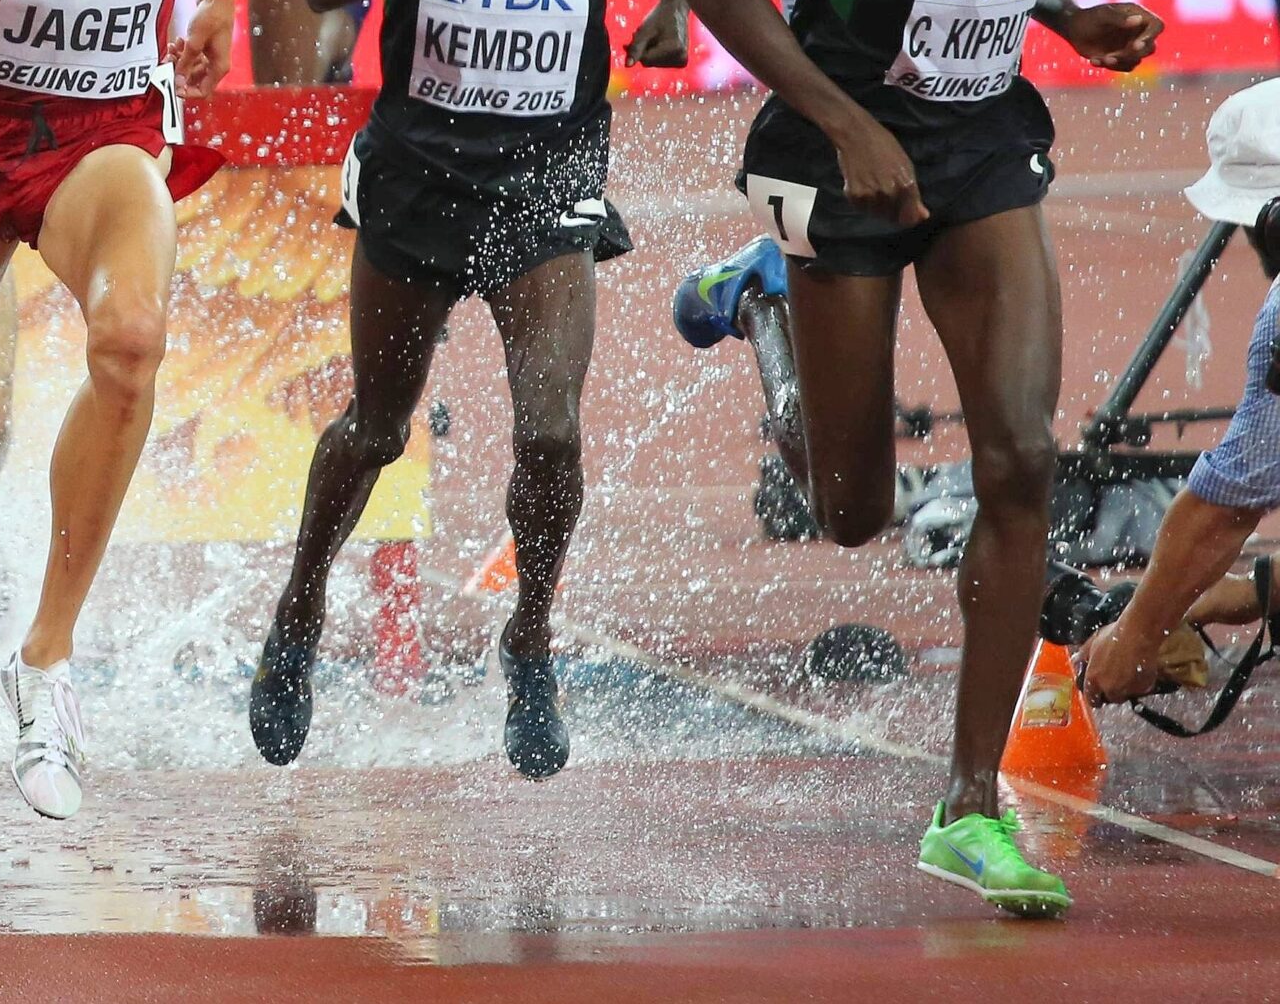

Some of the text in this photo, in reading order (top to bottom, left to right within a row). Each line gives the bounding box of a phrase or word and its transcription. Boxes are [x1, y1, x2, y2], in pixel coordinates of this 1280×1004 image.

[2, 2, 152, 53] JAGER
[423, 16, 572, 74] KEMBOI
[909, 16, 932, 58] C.
[99, 64, 152, 95] 2015
[417, 76, 567, 112] BEIJING 2015
[897, 72, 988, 97] BEIJING
[767, 195, 790, 242] 1
